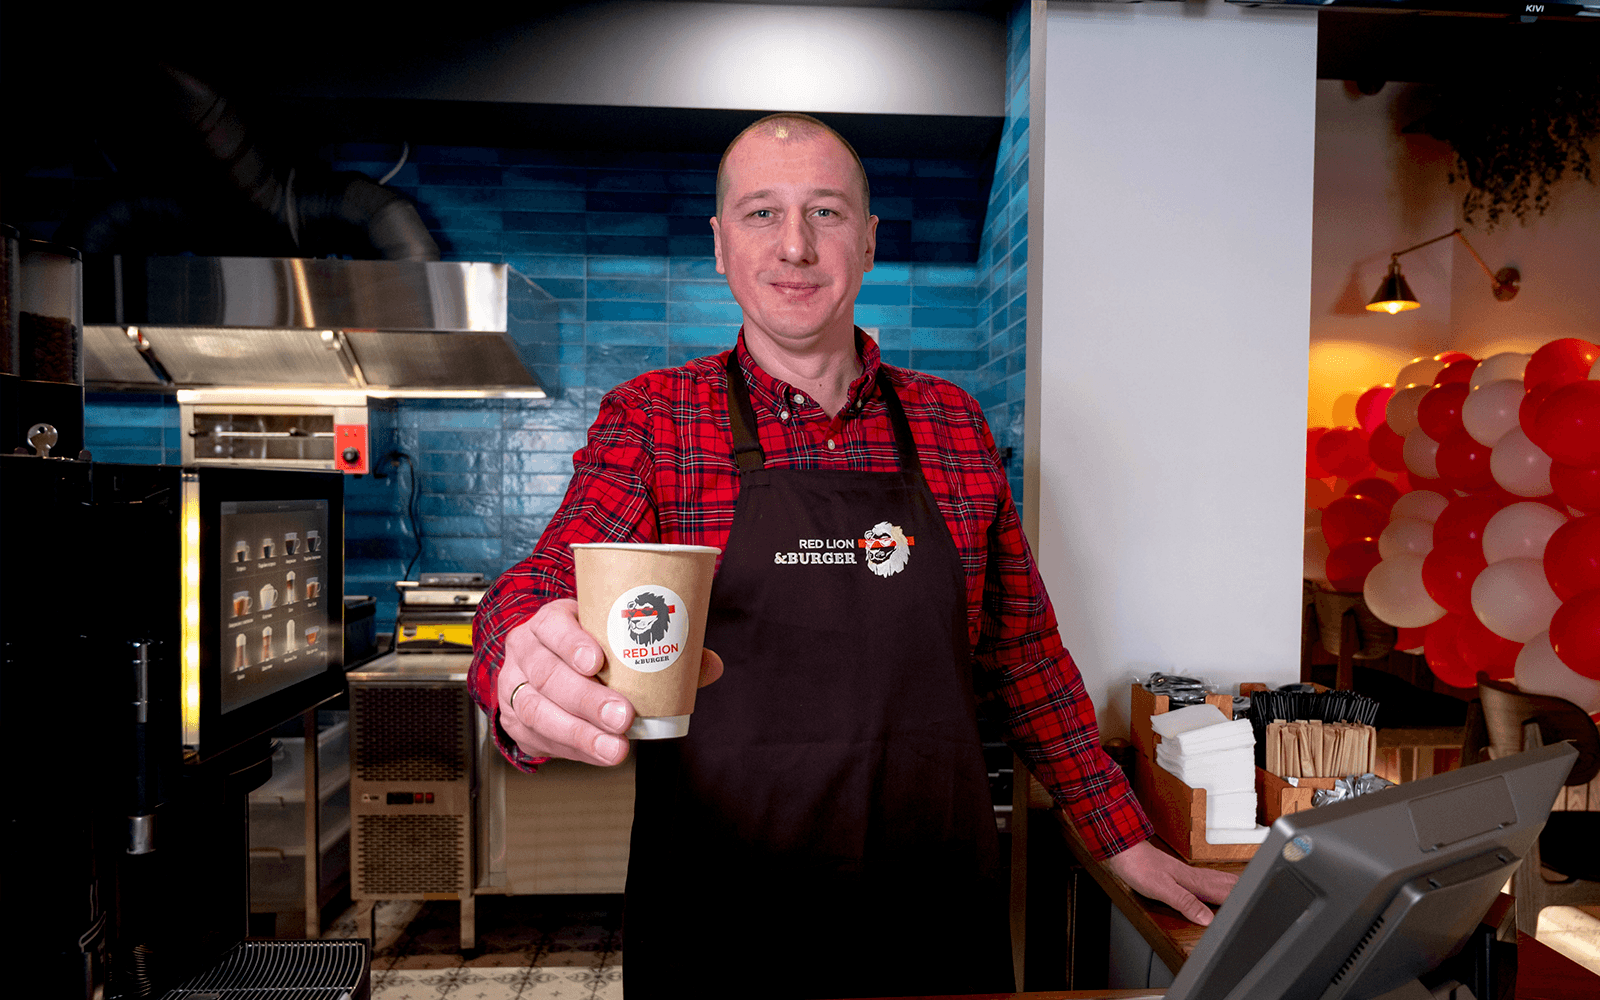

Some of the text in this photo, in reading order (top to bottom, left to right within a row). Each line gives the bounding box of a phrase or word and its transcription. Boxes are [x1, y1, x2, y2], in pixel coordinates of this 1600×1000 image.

[1525, 4, 1545, 13] KIVI
[799, 538, 855, 549] RED LION
[774, 552, 857, 565] &BURGER
[623, 643, 679, 659] RED LION
[634, 655, 670, 665] &BURGER
